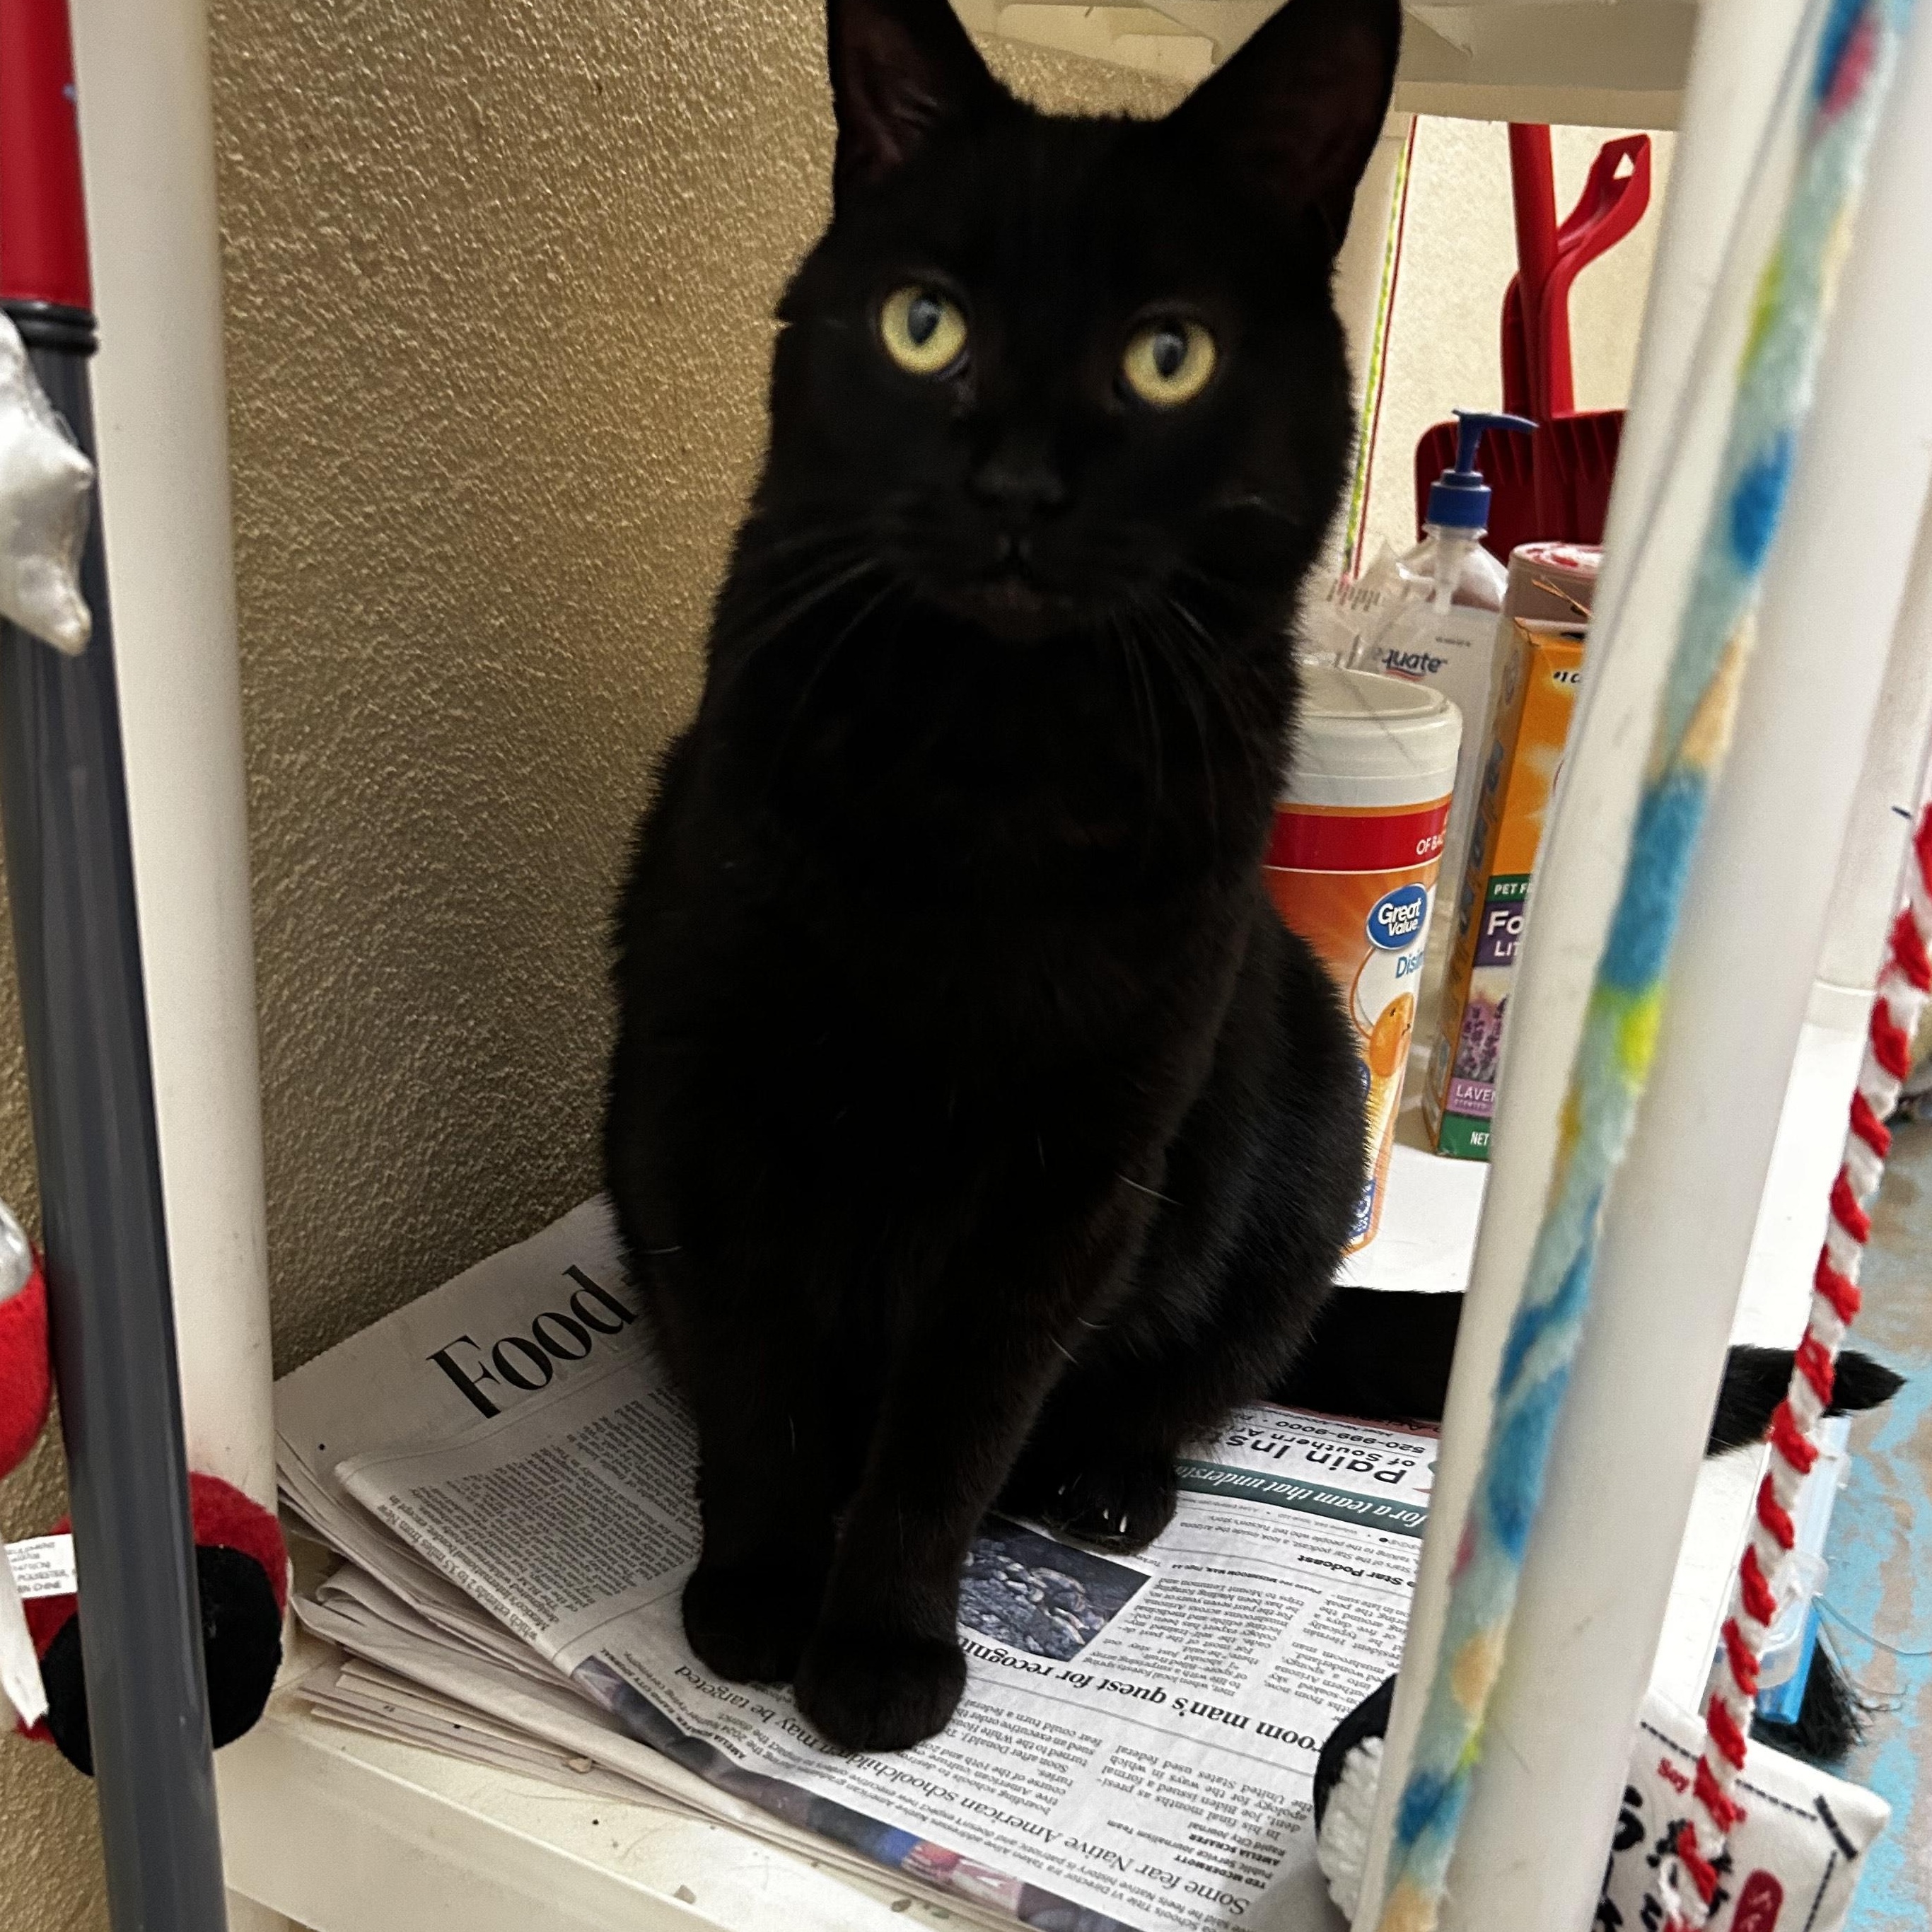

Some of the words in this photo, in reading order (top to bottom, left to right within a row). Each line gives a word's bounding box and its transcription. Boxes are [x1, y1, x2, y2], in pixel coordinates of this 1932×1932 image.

[1416, 837, 1431, 855] OF
[1494, 883, 1518, 895] PET
[1378, 897, 1421, 925] Great
[1388, 919, 1419, 936] Value
[1471, 1131, 1489, 1146] NET
[426, 1264, 636, 1419] Food
[1269, 1433, 1383, 1462] Southern
[1273, 1421, 1426, 1454] 520-999-9000
[1305, 1448, 1410, 1484] Pain
[1387, 1457, 1416, 1467] of
[1262, 1482, 1314, 1501] that
[1313, 1492, 1373, 1514] team
[1373, 1505, 1392, 1515] a
[1388, 1510, 1428, 1527] for
[1297, 1554, 1365, 1577] Podcast
[1366, 1571, 1404, 1585] Star
[674, 1664, 750, 1709] targeted
[1054, 1670, 1095, 1689] for
[1096, 1678, 1167, 1704] quest
[750, 1705, 776, 1723] be
[1172, 1697, 1250, 1729] man's
[774, 1711, 827, 1749] may
[820, 1745, 959, 1801] schoolchildren
[960, 1797, 1062, 1844] American
[1064, 1837, 1134, 1873] Native
[1134, 1864, 1182, 1890] fear
[1174, 1855, 1245, 1884] MCDERMOTT
[1245, 1878, 1266, 1890] TED
[1184, 1881, 1255, 1919] Some
